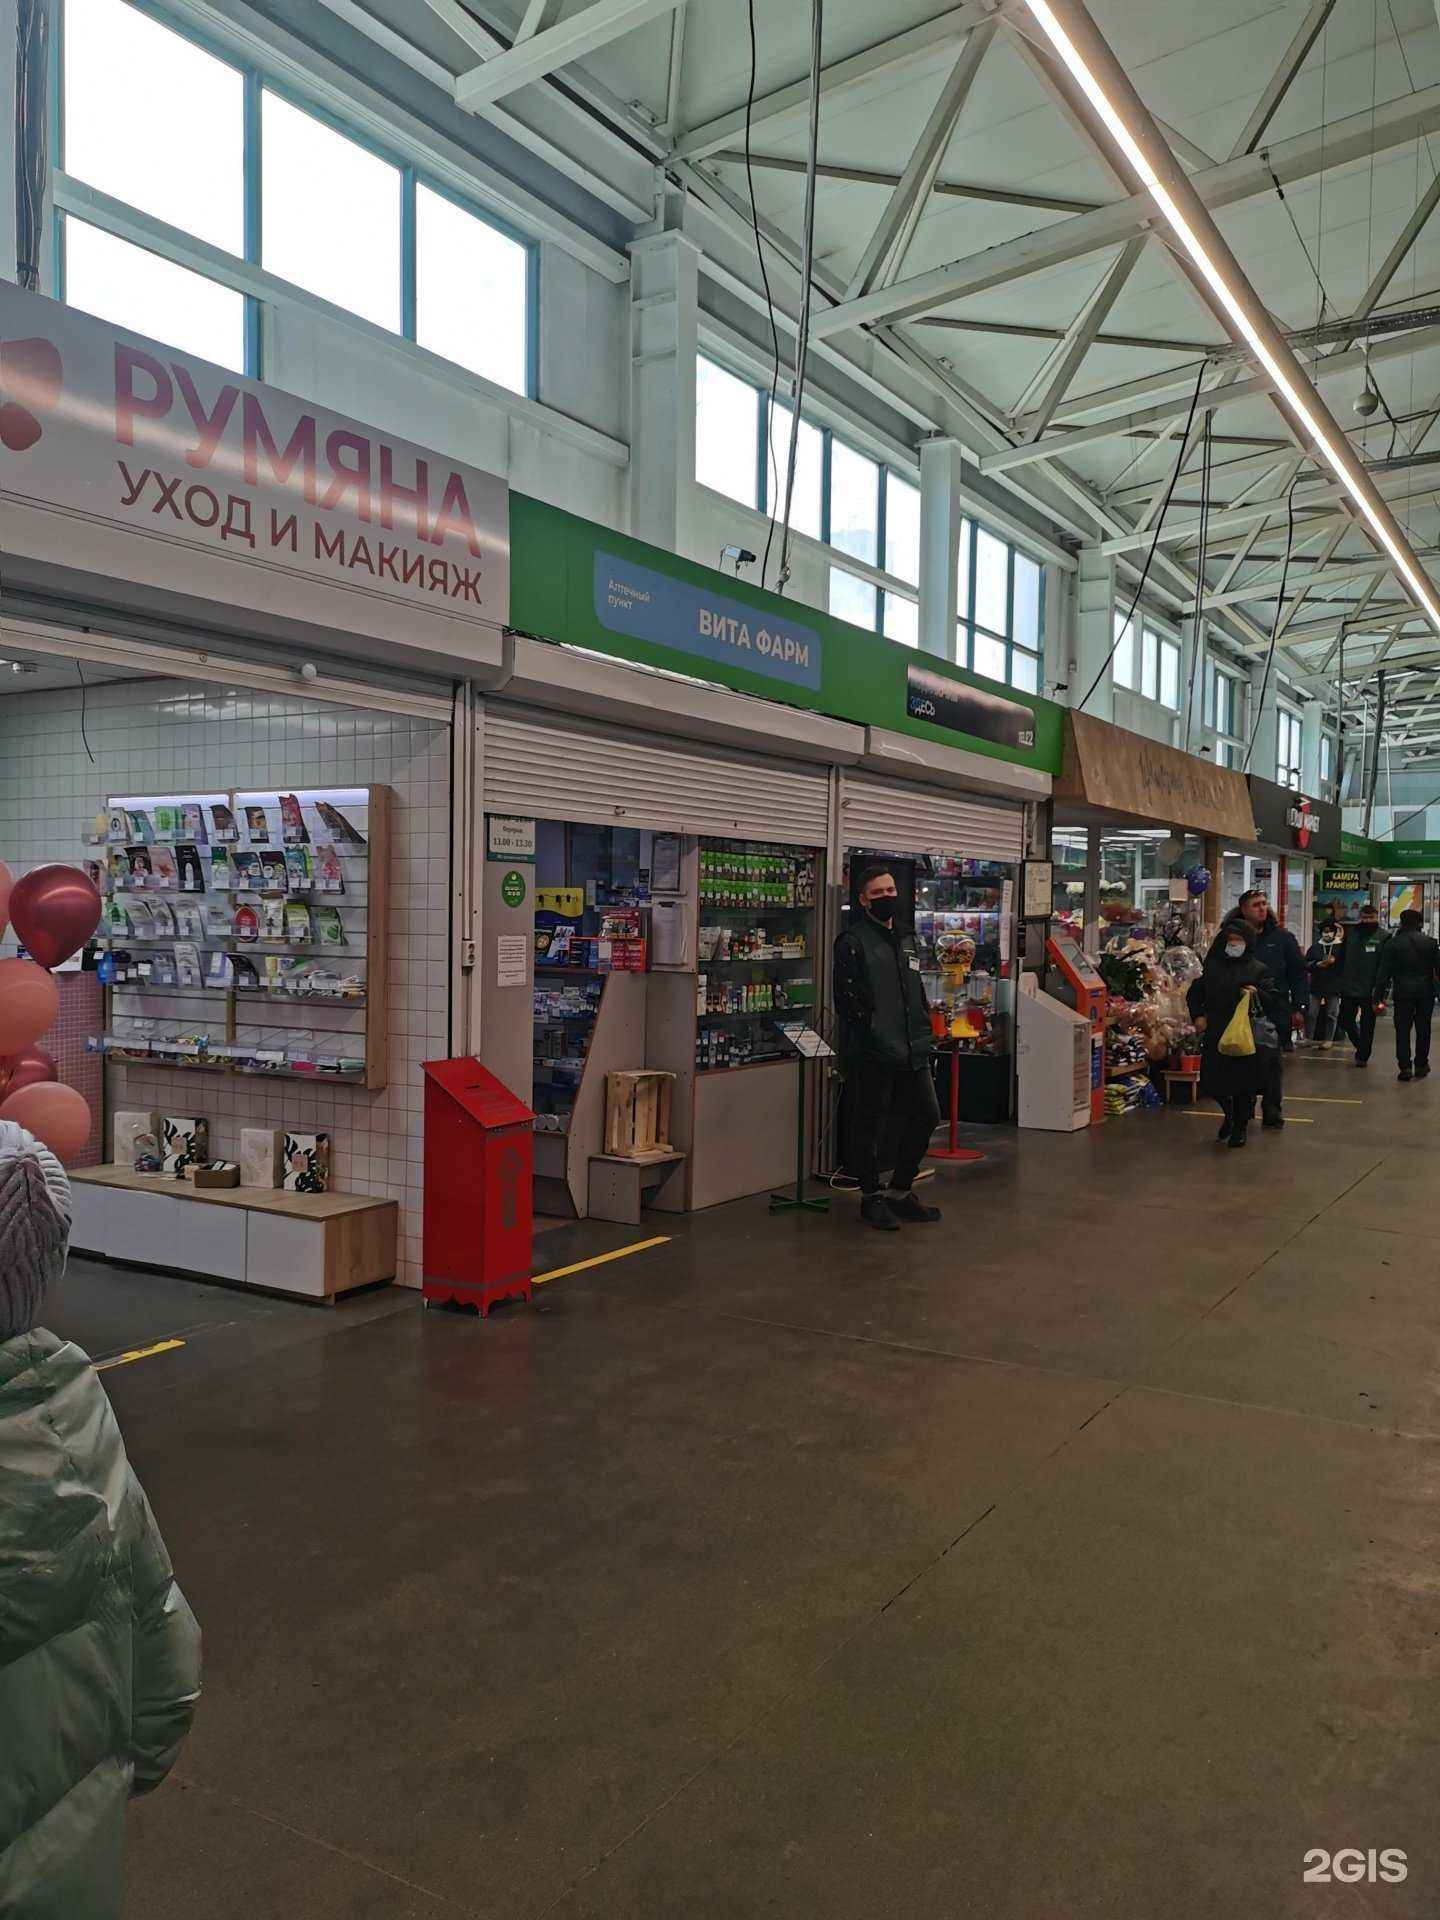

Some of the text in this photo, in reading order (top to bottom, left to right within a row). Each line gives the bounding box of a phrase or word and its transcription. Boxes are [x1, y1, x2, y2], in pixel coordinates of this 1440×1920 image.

[114, 342, 482, 559] РУМЯНА
[118, 461, 483, 605] УХОД И МАКИЯЖ
[608, 579, 650, 604] Аптечный
[608, 595, 632, 609] пункт
[699, 608, 809, 668] ВИТА ФАРМ
[1332, 872, 1360, 881] КАМЕРА
